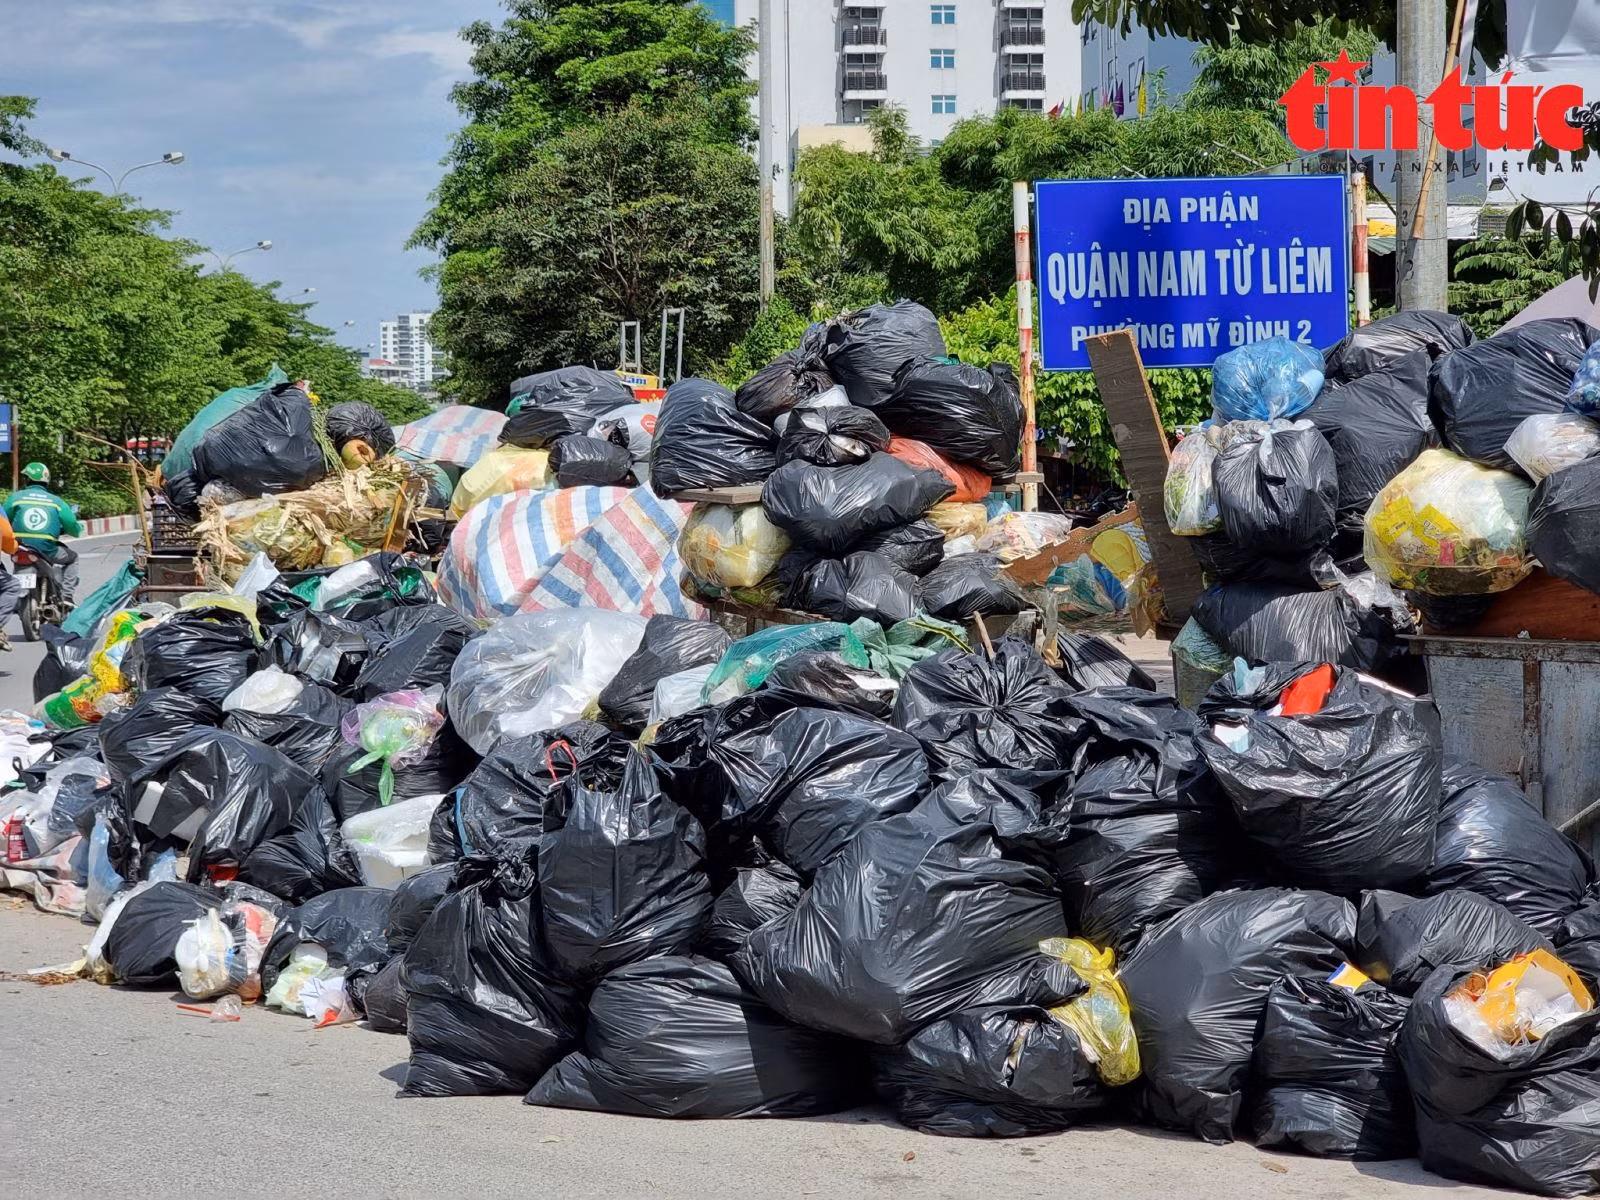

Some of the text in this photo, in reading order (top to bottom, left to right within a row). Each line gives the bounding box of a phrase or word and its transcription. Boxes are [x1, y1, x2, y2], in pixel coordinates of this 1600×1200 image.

[1123, 191, 1259, 230] ĐỊA PHẬN
[1047, 237, 1332, 308] QUẬN NAM TỪ LIÊM
[1182, 317, 1220, 348] MỸ
[1228, 314, 1290, 346] ĐÌNH
[1297, 319, 1312, 344] 2
